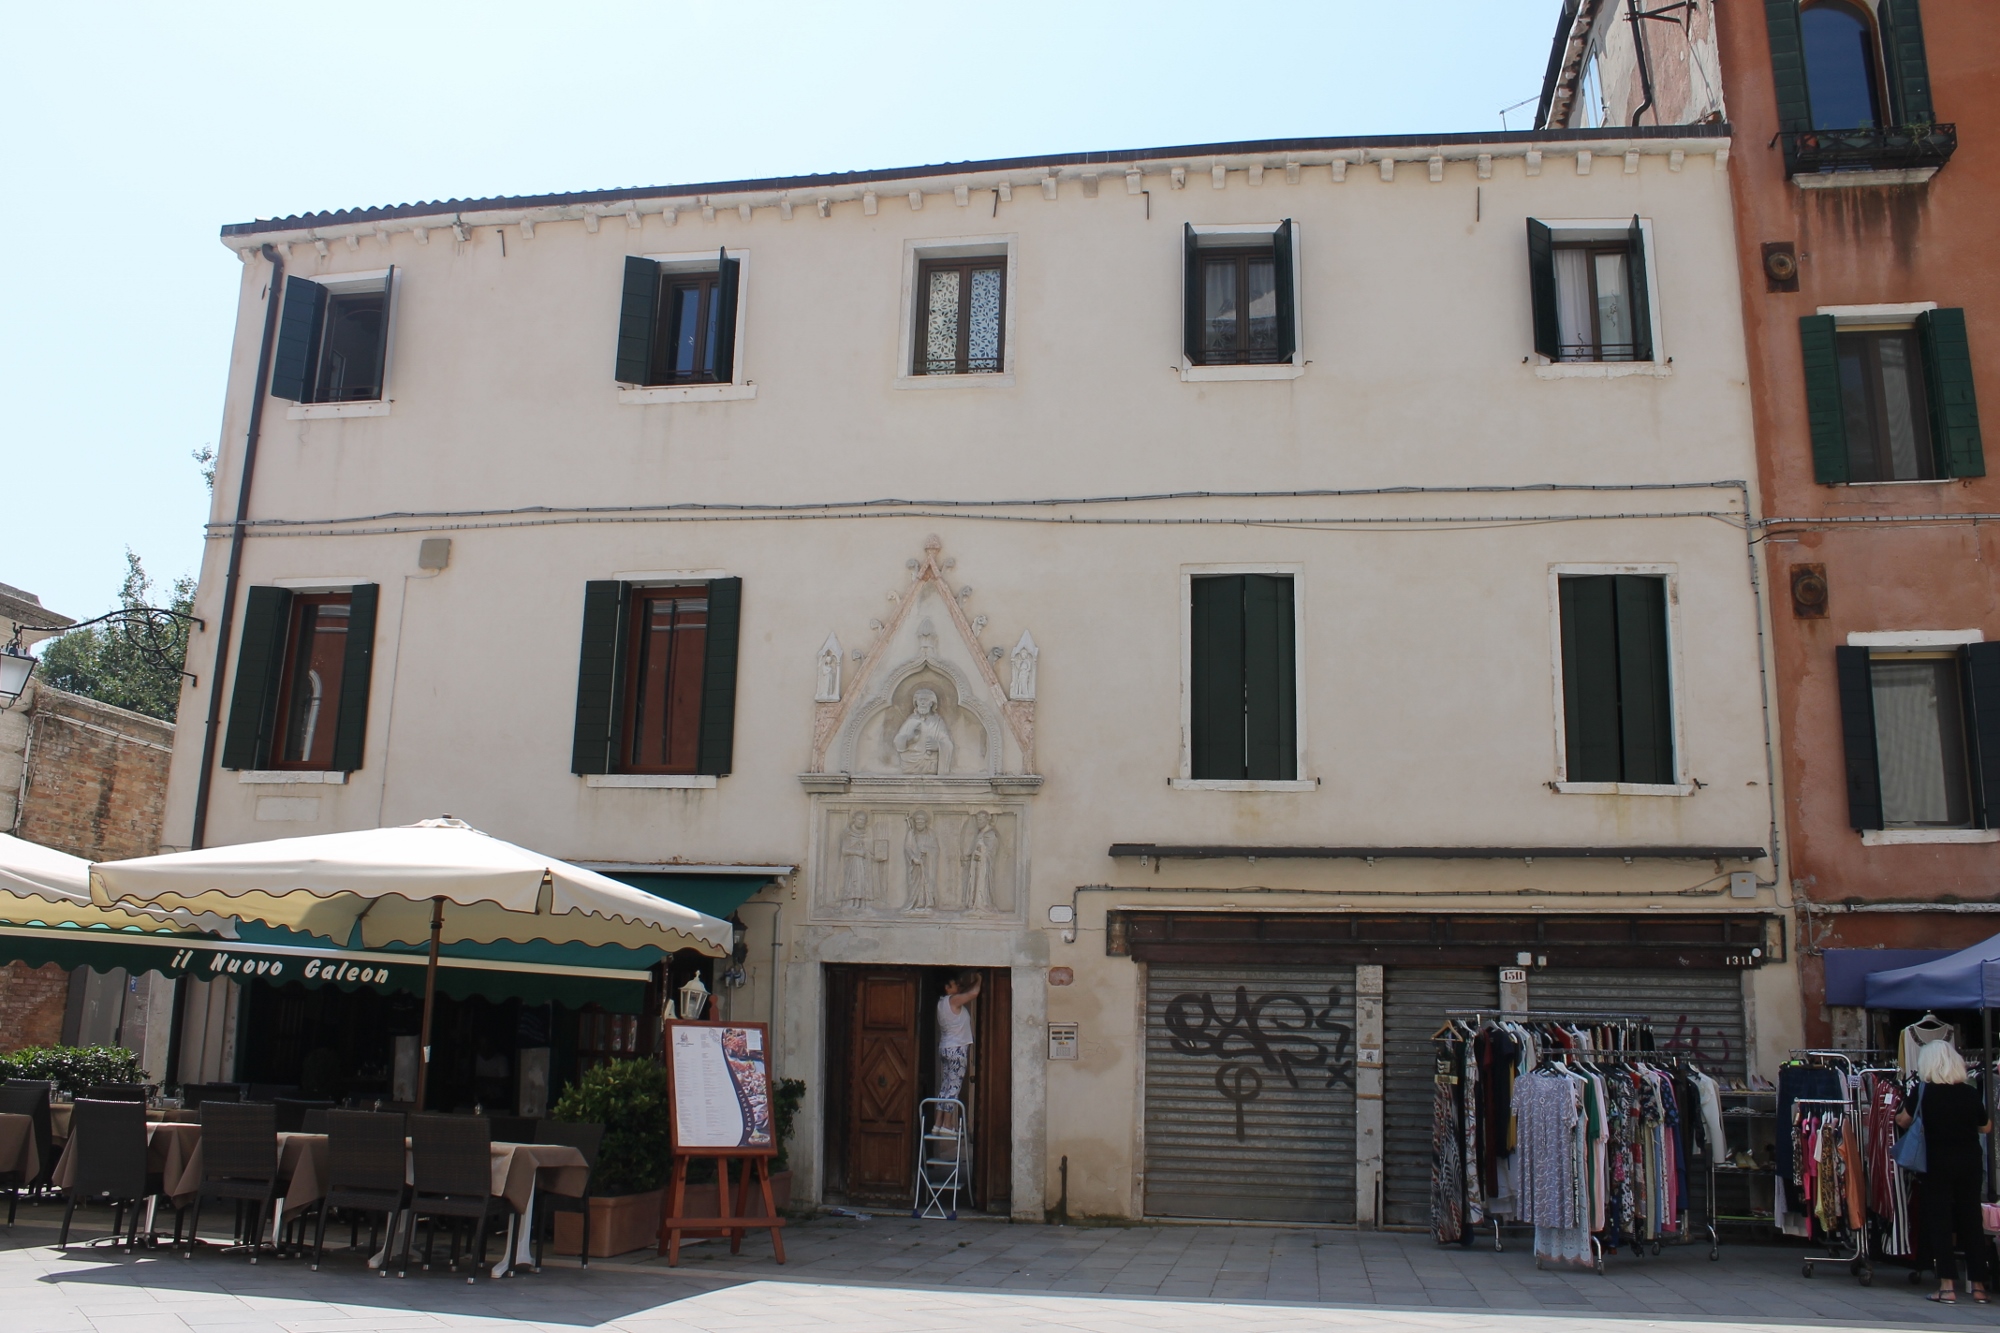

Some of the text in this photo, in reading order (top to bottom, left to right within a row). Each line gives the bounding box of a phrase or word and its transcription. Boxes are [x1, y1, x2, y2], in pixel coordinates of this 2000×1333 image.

[171, 949, 389, 984] il Nuovo Galeon
[1726, 956, 1752, 965] 1311
